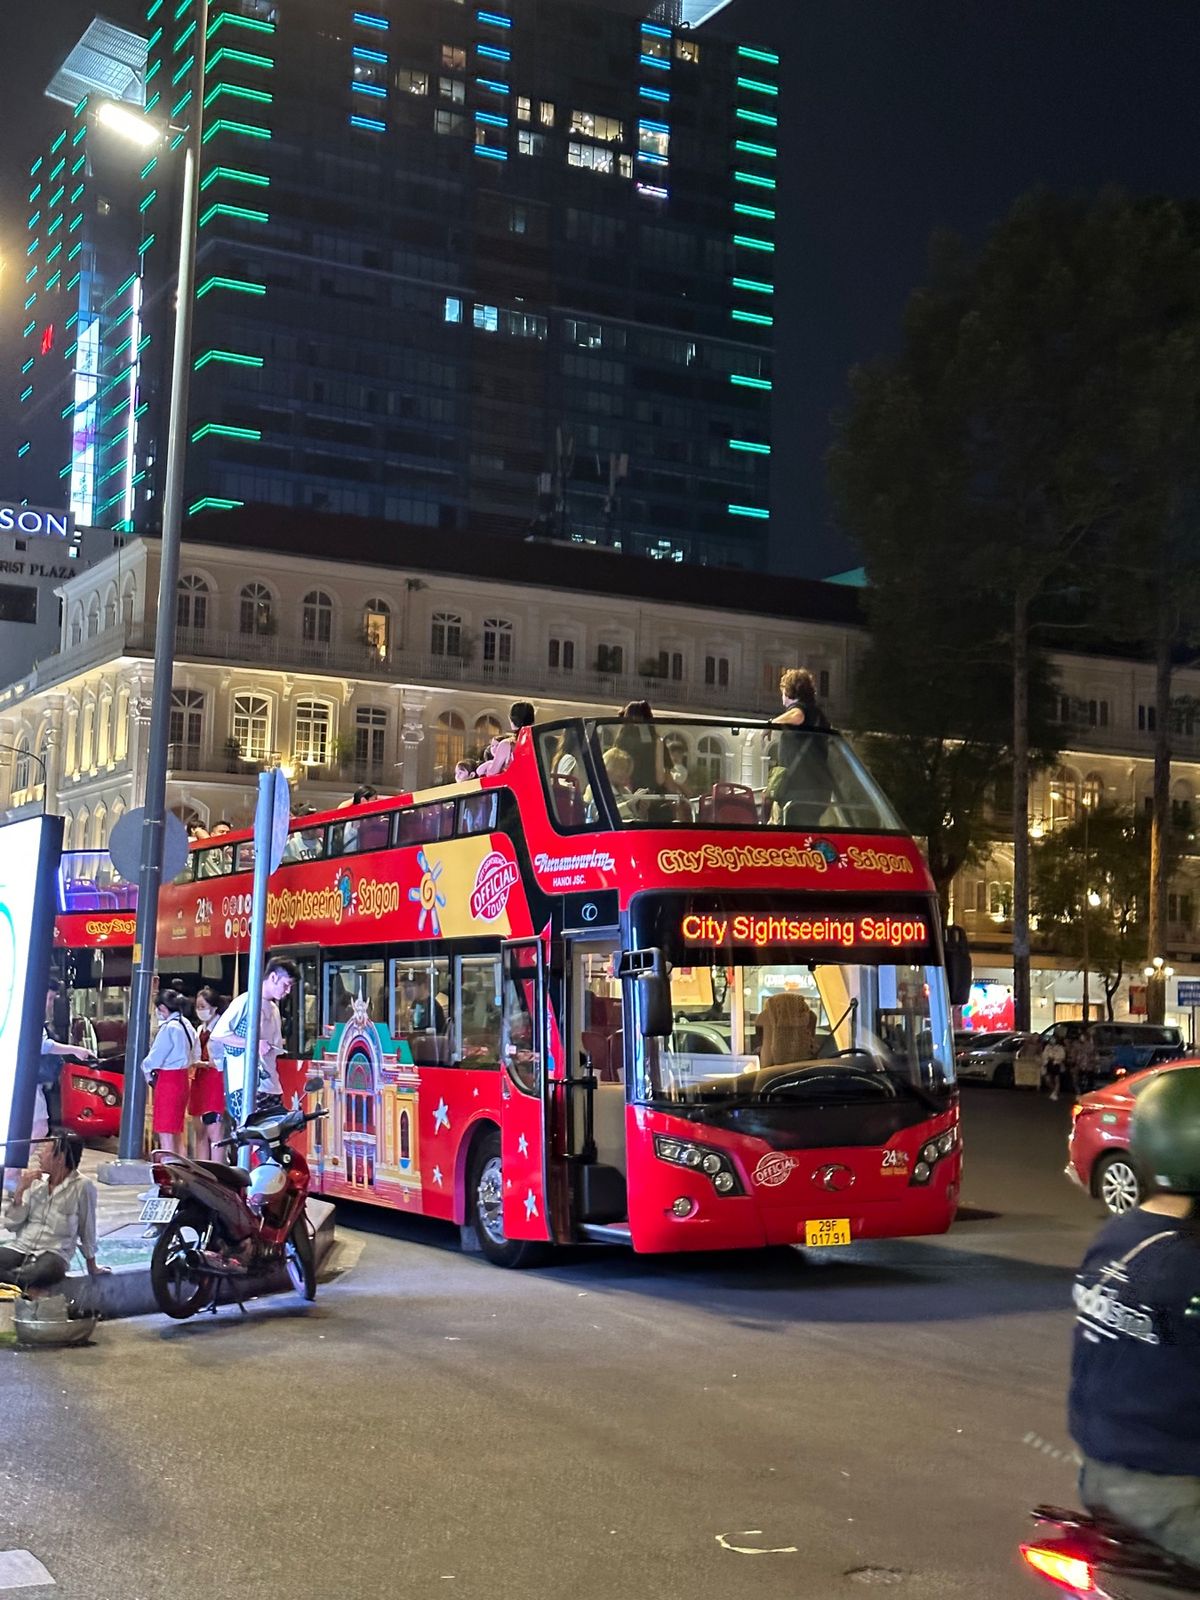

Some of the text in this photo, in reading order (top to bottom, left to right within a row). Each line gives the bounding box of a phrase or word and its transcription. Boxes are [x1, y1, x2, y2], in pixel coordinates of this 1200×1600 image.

[0, 508, 67, 536] SON
[30, 563, 76, 580] PLAZA
[848, 847, 913, 873] Saigon
[474, 865, 515, 912] OFFICIAL
[552, 876, 572, 888] HANOI
[358, 877, 399, 919] Saigon
[487, 892, 506, 917] TOUR
[682, 915, 926, 946] City Sightseeing Saigon
[756, 1158, 797, 1182] OFFICIAL
[818, 1220, 838, 1232] 29F
